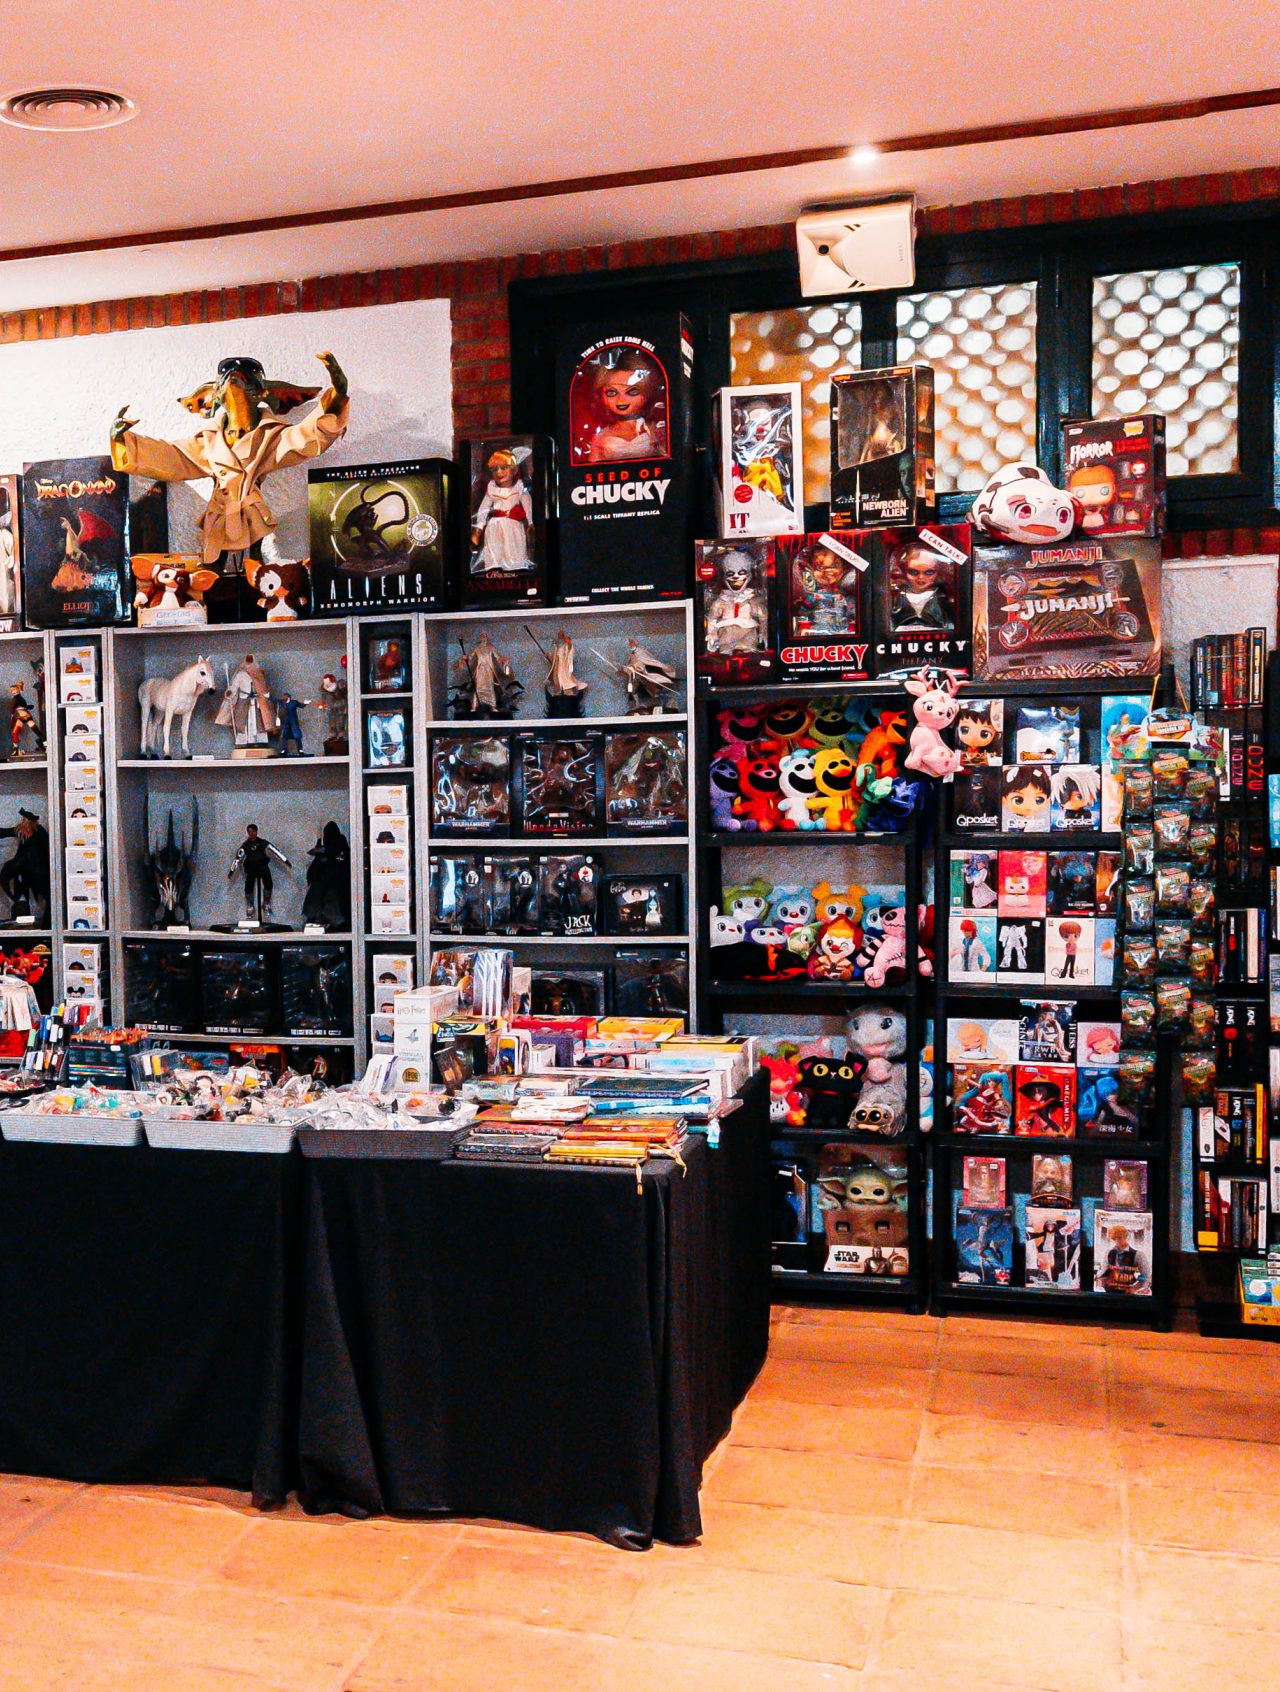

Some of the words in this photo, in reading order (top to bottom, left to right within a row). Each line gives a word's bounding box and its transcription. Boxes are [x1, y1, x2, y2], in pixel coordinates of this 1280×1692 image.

[581, 346, 596, 358] TIME
[624, 336, 641, 344] SOME
[642, 340, 656, 352] HELL
[1070, 441, 1114, 467] HORROR
[585, 471, 629, 483] SEED
[640, 467, 662, 479] OF
[571, 479, 671, 506] CHUCKY
[862, 500, 907, 511] NEWBORN
[880, 507, 907, 518] ALIEN
[729, 512, 750, 529] IT
[928, 536, 943, 548] CAN
[1026, 547, 1103, 568] JUMANJI
[330, 574, 422, 600] ALIENS
[320, 600, 382, 608] XENOMORPH
[388, 596, 436, 604] WARRIOR
[1021, 593, 1113, 620] JUMANJI
[876, 641, 966, 654] CHUCKY
[781, 644, 868, 669] CHUCKY
[902, 657, 943, 665] TIFFANY
[1247, 745, 1264, 790] DUNE
[524, 819, 594, 832] WandaVision
[956, 813, 998, 826] Qposket
[1056, 813, 1096, 828] Qposket
[564, 915, 591, 930] JACK
